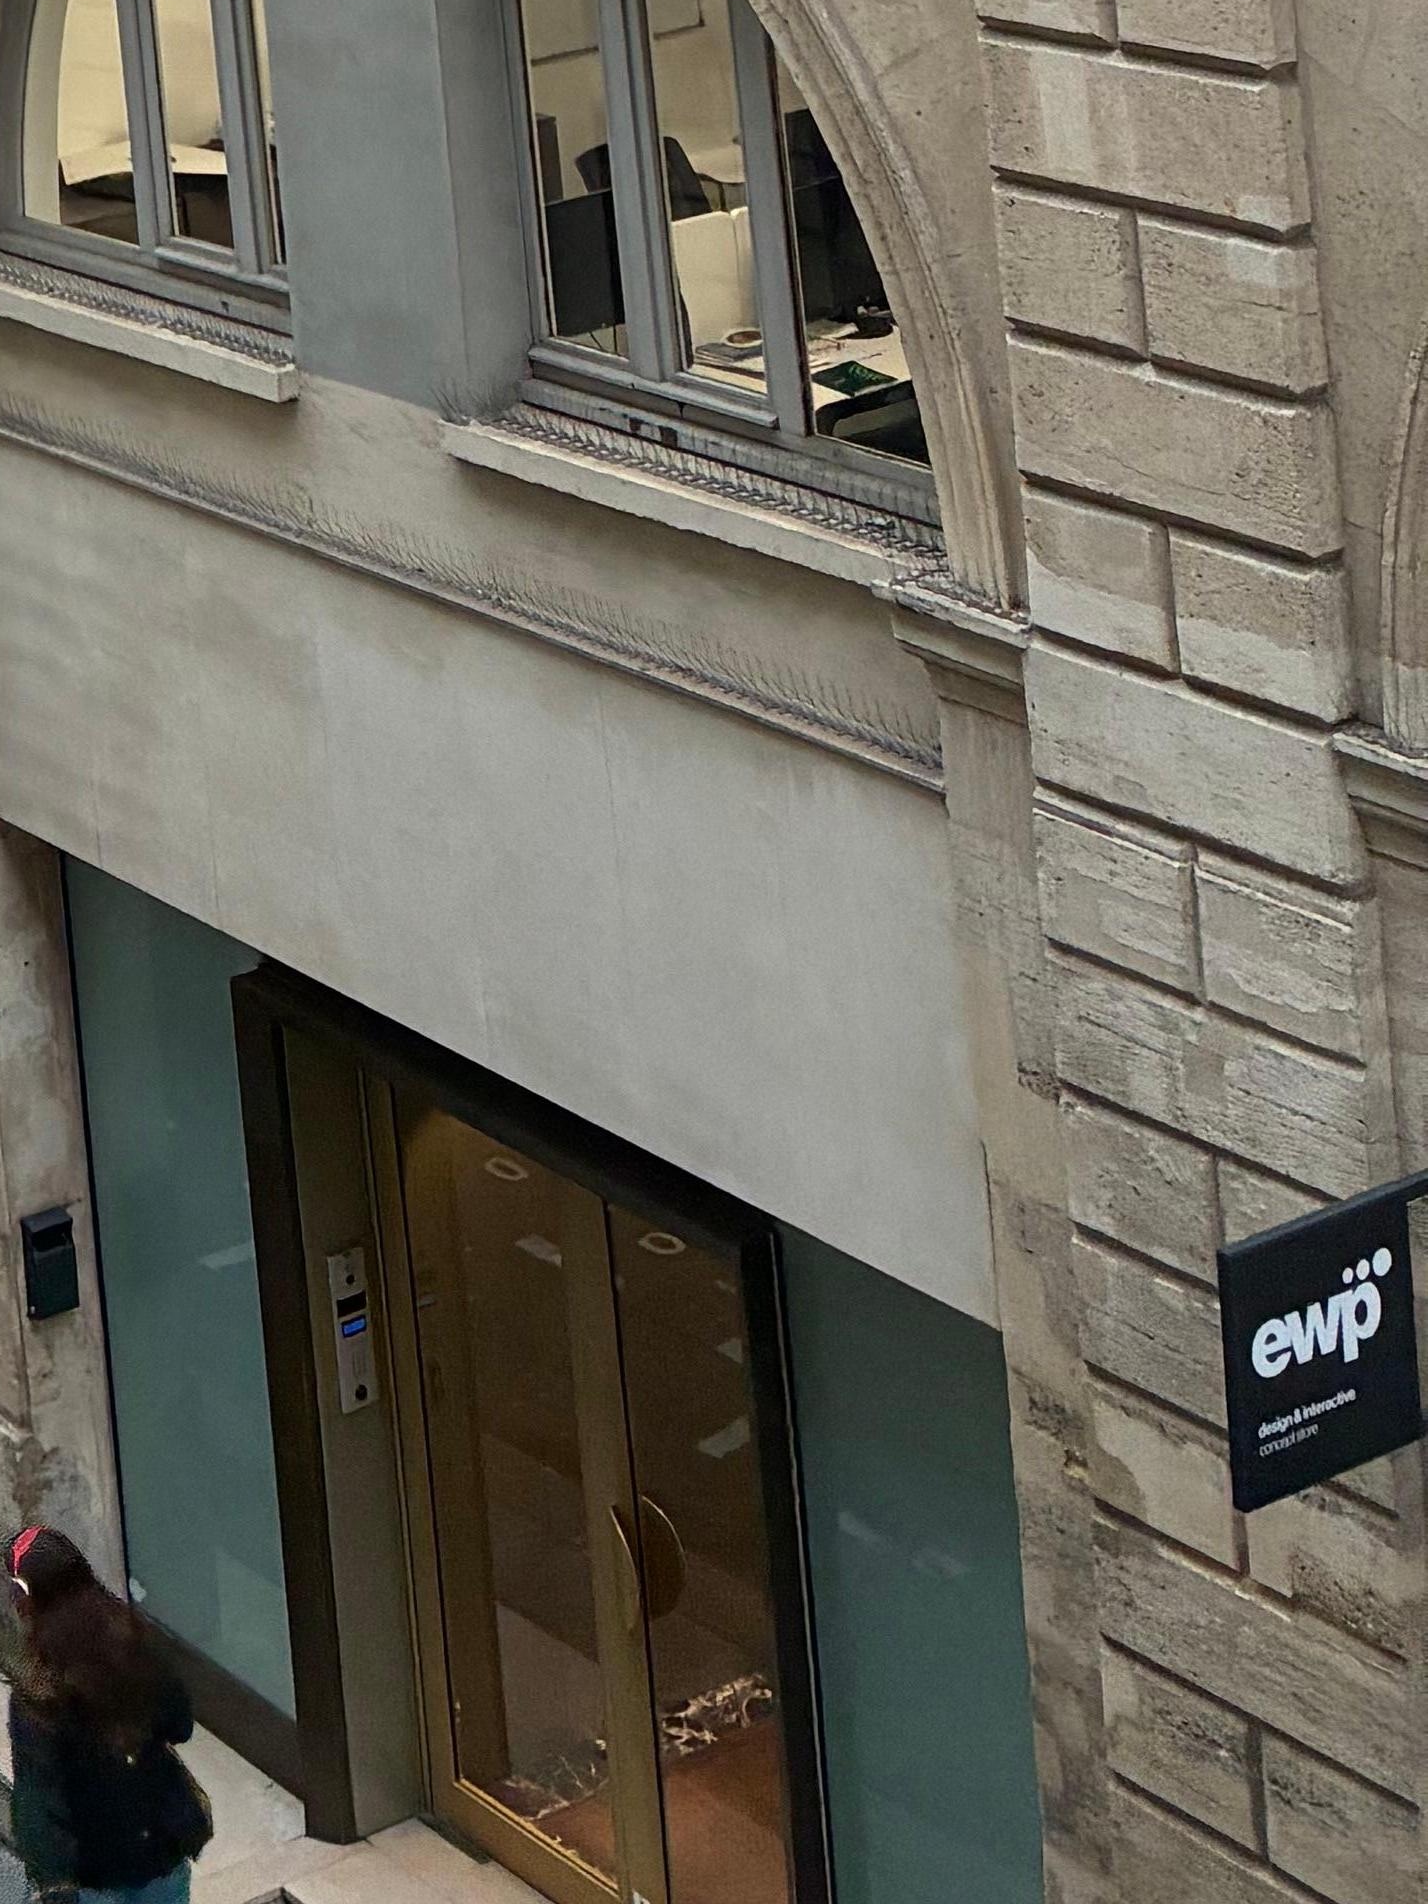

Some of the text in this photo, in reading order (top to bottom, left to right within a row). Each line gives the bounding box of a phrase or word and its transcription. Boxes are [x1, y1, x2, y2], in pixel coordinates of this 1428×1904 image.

[1251, 1280, 1383, 1379] ewp
[1258, 1416, 1294, 1440] design
[1302, 1388, 1356, 1421] interactive
